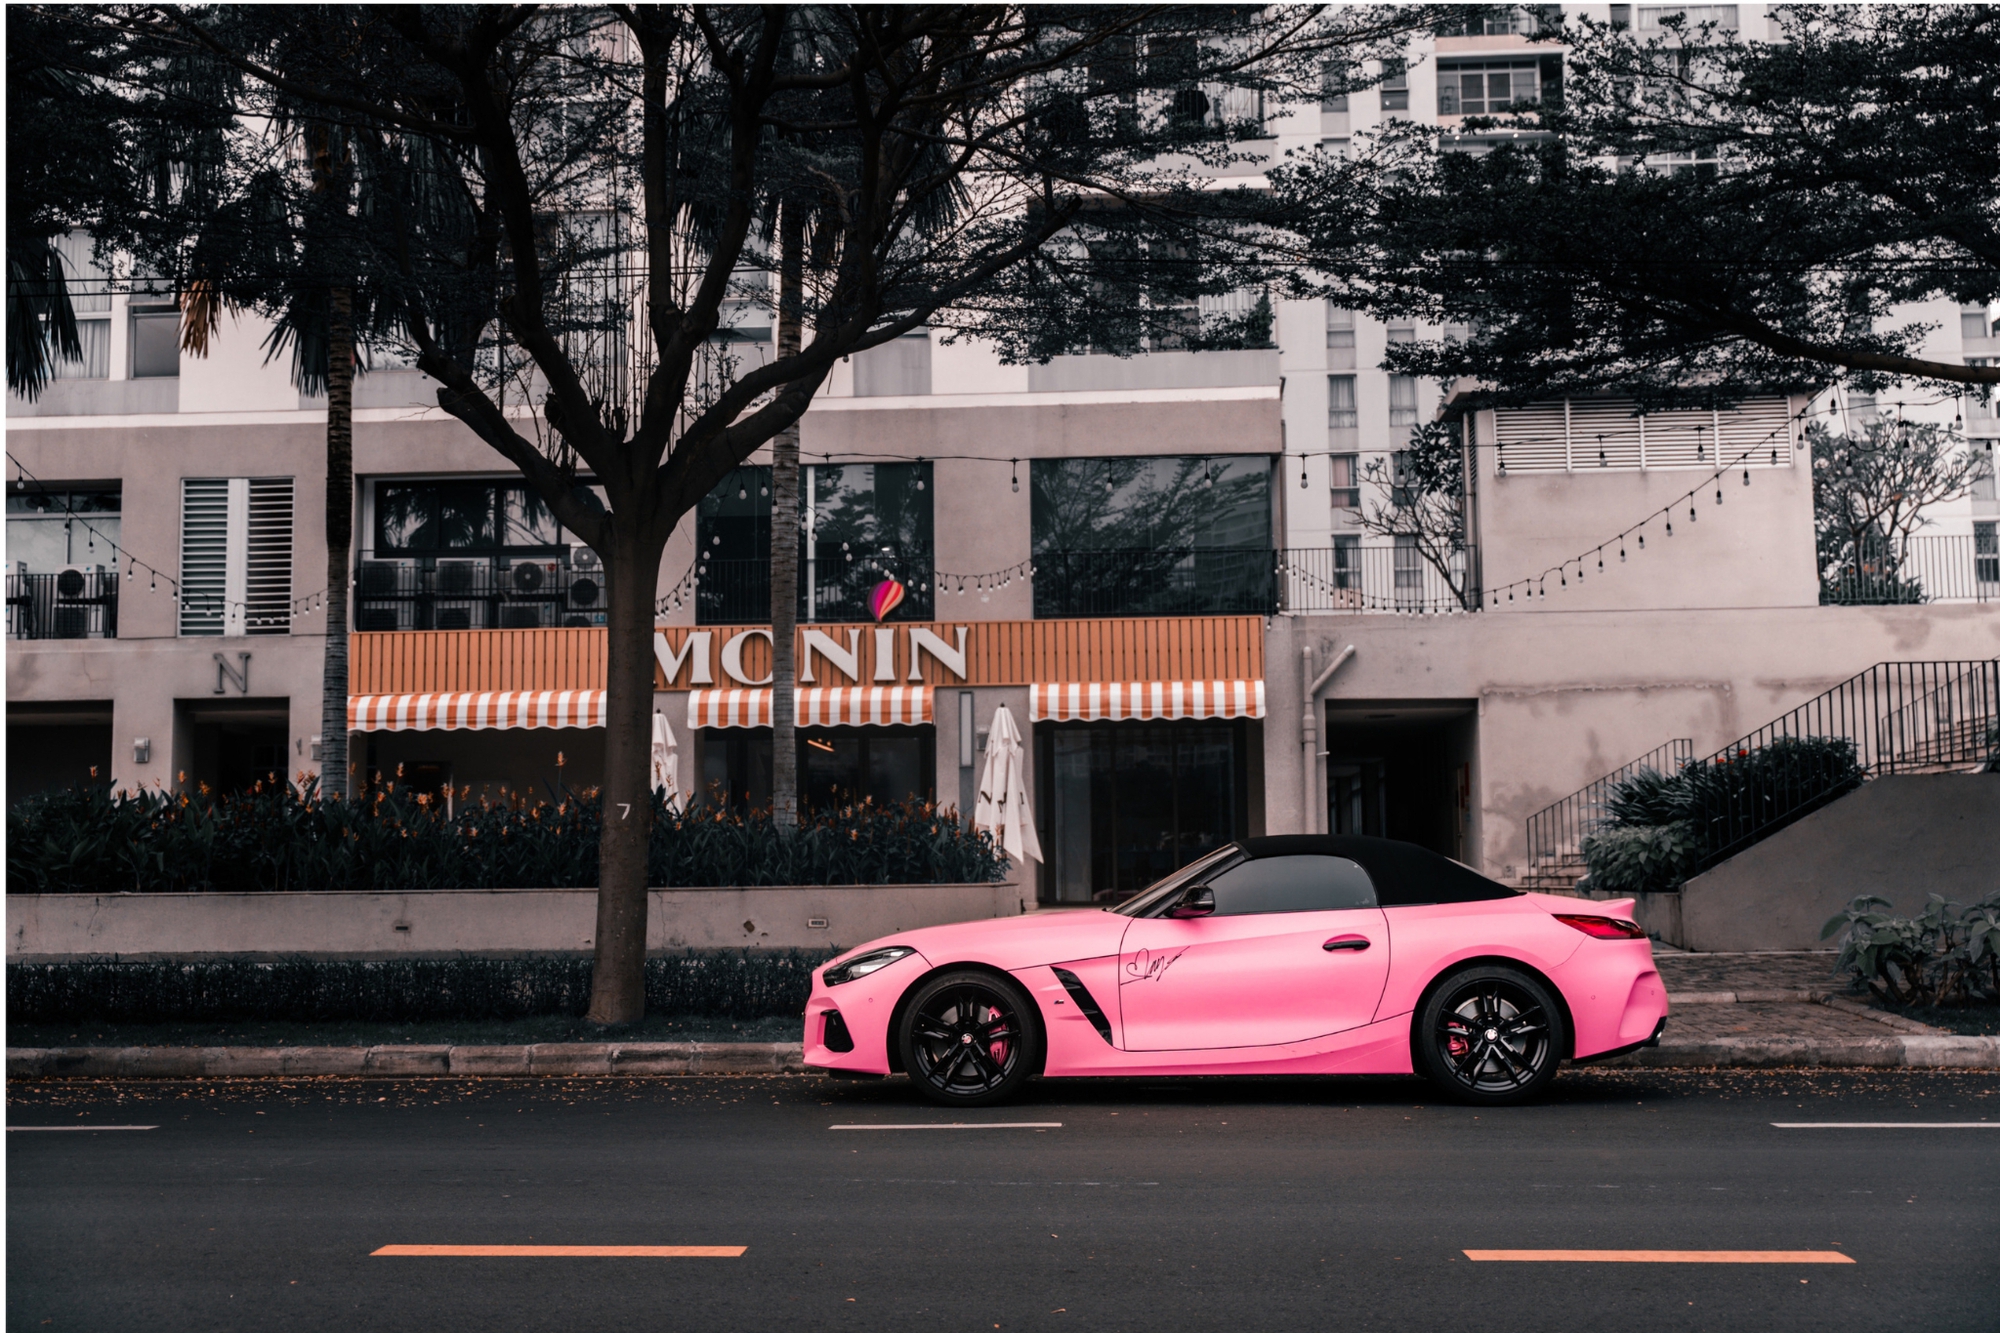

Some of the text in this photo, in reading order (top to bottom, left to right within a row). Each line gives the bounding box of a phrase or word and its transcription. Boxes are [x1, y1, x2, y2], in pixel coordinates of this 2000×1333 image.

[213, 652, 252, 695] N
[653, 628, 968, 685] MONIN
[616, 803, 631, 820] 7
